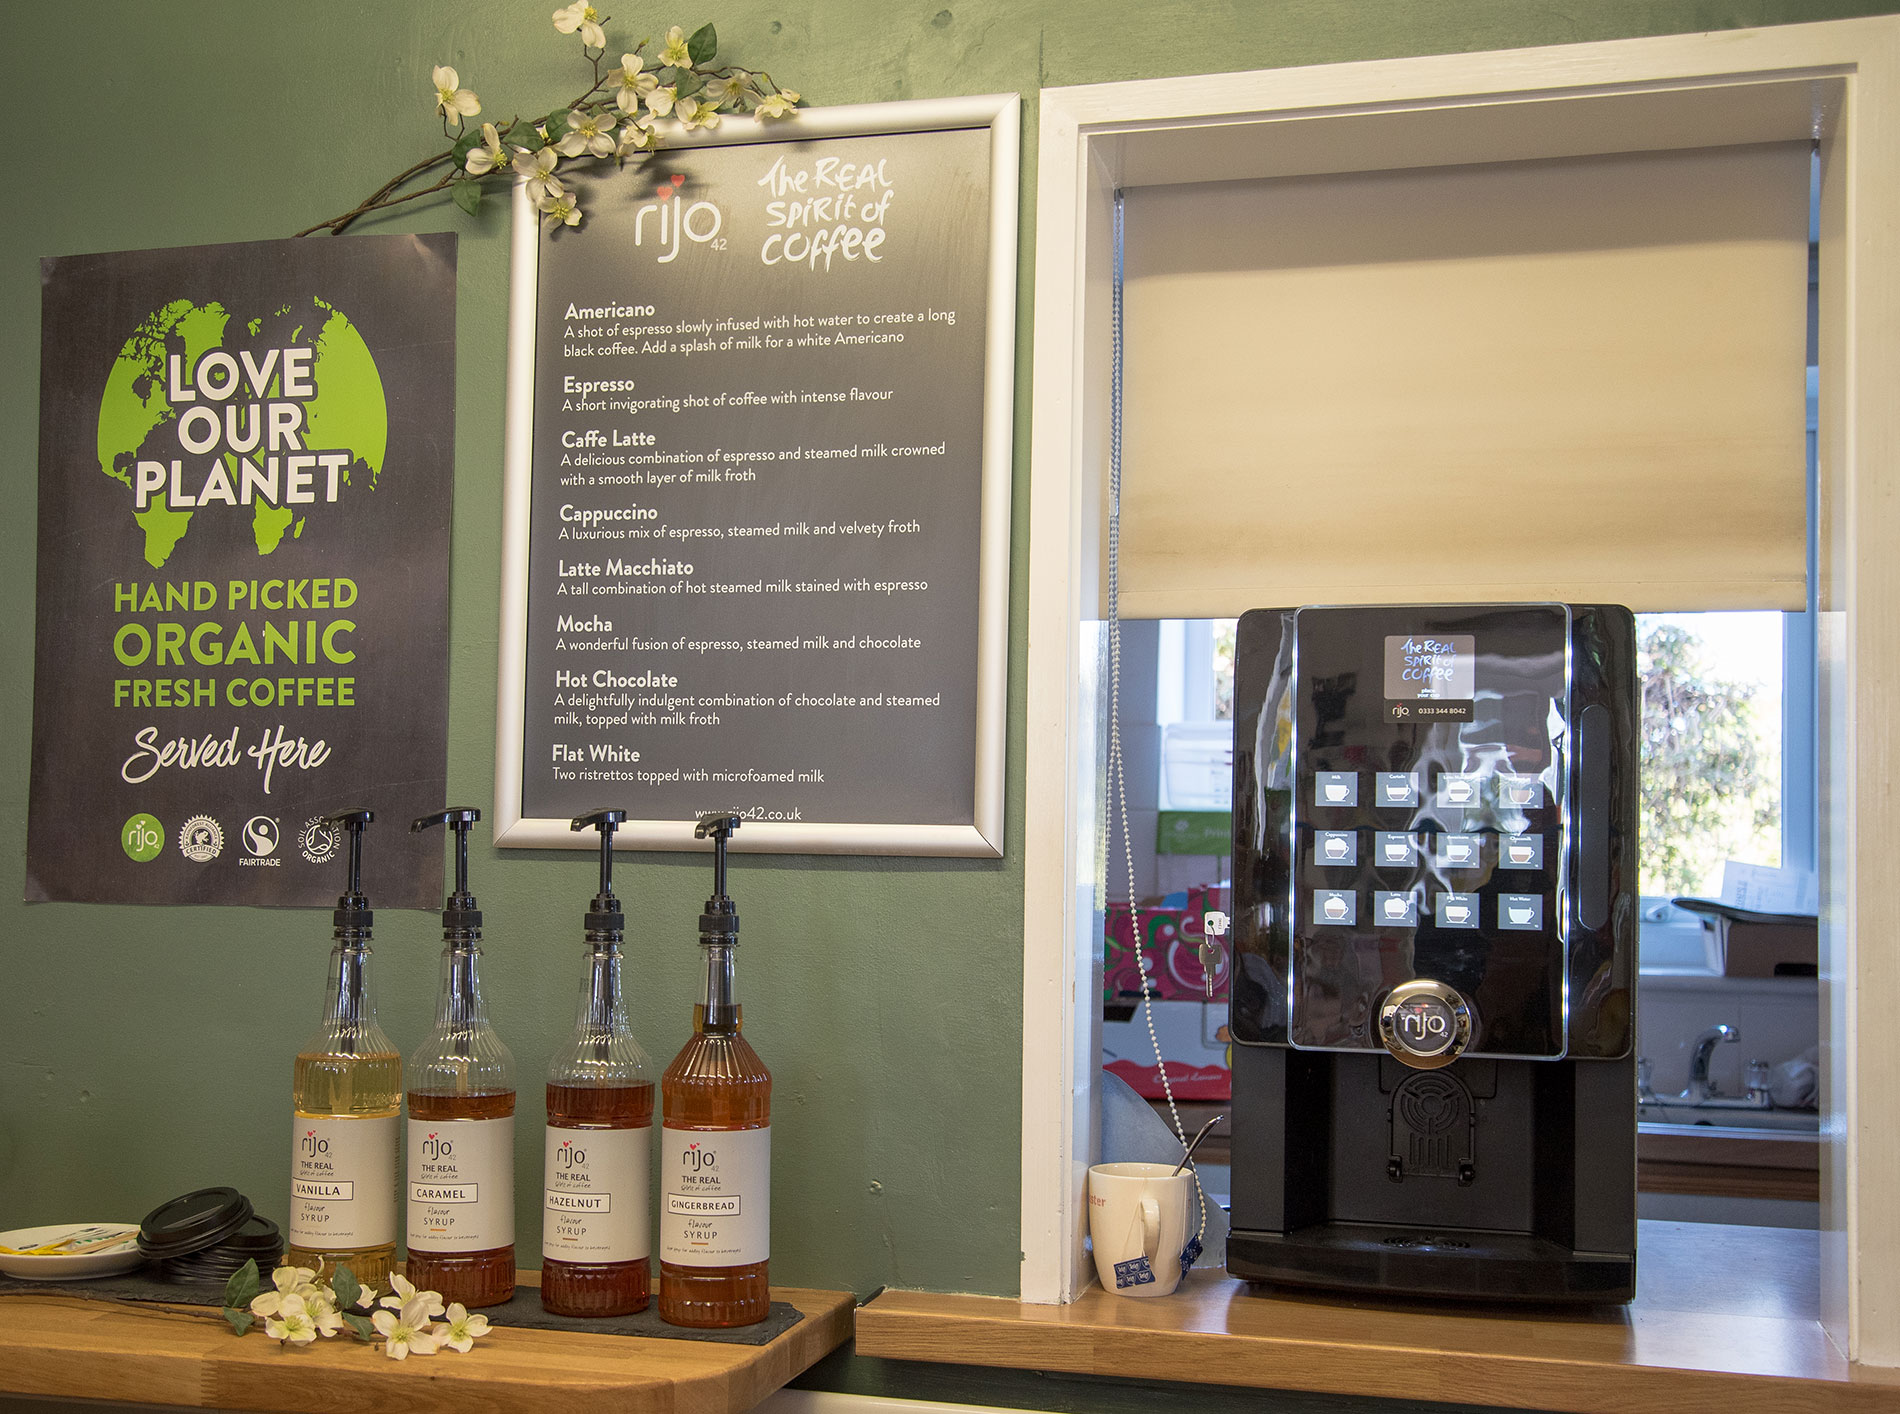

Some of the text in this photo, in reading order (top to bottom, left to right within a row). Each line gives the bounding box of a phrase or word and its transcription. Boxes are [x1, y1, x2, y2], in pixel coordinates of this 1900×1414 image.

[757, 154, 894, 198] The REAL
[859, 189, 895, 227] of
[634, 181, 722, 264] rijo
[710, 238, 728, 251] 42
[761, 223, 886, 273] coffee
[564, 300, 655, 320] Americano
[563, 308, 956, 340] A shot of espresso slowly infused with hot water to create a long
[564, 330, 904, 357] black coffee. Add a splash of milk for a white Americano
[169, 346, 314, 403] LOVE
[563, 375, 635, 399] Espresso
[561, 387, 893, 414] A short invigorating shot of coffee with intense flavour
[177, 402, 303, 456] OUR
[561, 429, 656, 448] Caffe Latte
[560, 440, 945, 466] A delicious combination of espresso and steamed milk crowned
[135, 453, 349, 508] PLANET
[560, 467, 756, 488] with a smooth layer of milk froth
[559, 502, 658, 527] Cappuccino
[558, 519, 920, 542] A luxurious mix of espresso, steamed milk and velvety froth
[558, 558, 694, 577] Latte Macchiato
[114, 577, 359, 613] HAND PICKED
[556, 577, 928, 595] A tall combination of hot steamed milk stained with espresso
[556, 614, 612, 632] Mocha
[113, 620, 357, 667] ORGANIC
[555, 634, 921, 654] A wonderful fusion of espresso, steamed milk and chocolate
[1400, 638, 1456, 654] The REAL
[556, 669, 678, 688] Hot Chocolate
[113, 677, 356, 708] FRESH COFFEE
[553, 692, 940, 711] A delightfully indulgent combination of chocolate and steamed
[554, 711, 720, 729] milk, topped with milk froth
[1392, 704, 1410, 718] rijo
[1418, 707, 1466, 715] 0333 344 8042
[121, 724, 332, 795] Served Here
[552, 743, 640, 762] Flat White
[552, 766, 824, 786] Two ristrettos topped with microfoamed milk
[128, 823, 159, 852] rijo
[297, 829, 307, 850] SOIL
[185, 845, 218, 855] CERTIFIED
[301, 850, 336, 864] ORGANIC
[239, 858, 281, 867] FAIRTRADE
[1404, 1008, 1446, 1040] rijo
[301, 1132, 330, 1158] rijo
[422, 1135, 453, 1161] rijo
[556, 1143, 586, 1169] rijo
[682, 1146, 715, 1172] rijo
[296, 1183, 341, 1196] VANILLA
[416, 1188, 466, 1199] CARAMEL
[549, 1195, 602, 1209] HAZELNUT
[671, 1199, 735, 1211] GINGERBREAD
[300, 1212, 330, 1223] SYRUP
[423, 1217, 455, 1227] SYRUP
[556, 1225, 587, 1236] SYRUP
[683, 1230, 718, 1240] SYRUP
